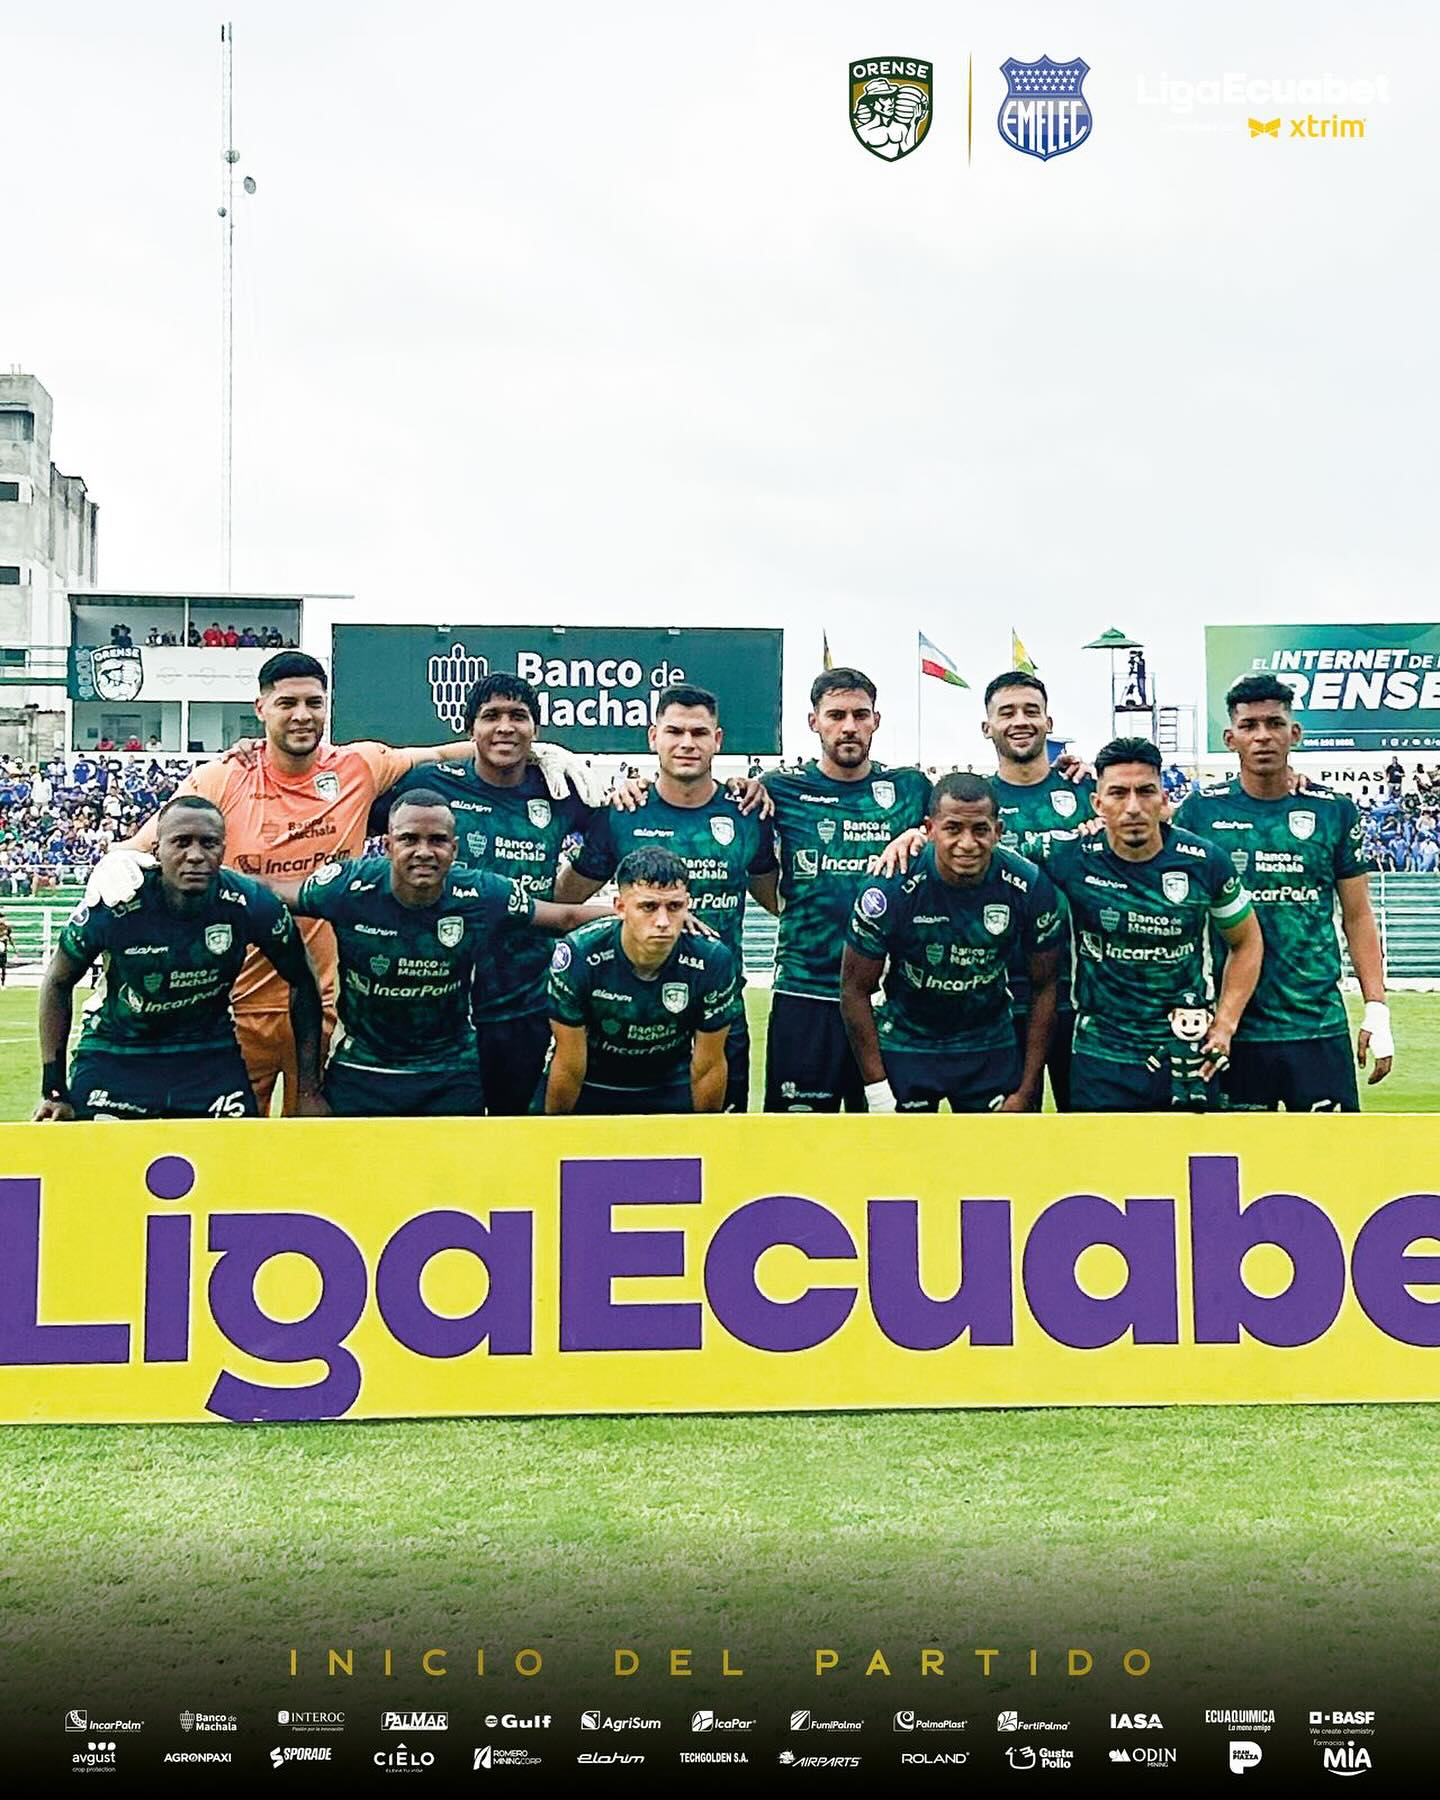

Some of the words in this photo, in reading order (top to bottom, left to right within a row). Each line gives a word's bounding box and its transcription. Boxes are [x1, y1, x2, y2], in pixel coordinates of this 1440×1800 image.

[1252, 658, 1269, 670] EL
[1270, 649, 1409, 670] INTERNET
[1408, 655, 1433, 669] DE
[518, 652, 642, 688] Banco
[650, 661, 685, 688] de
[1231, 671, 1440, 710] RENSE
[538, 690, 660, 727] achal
[843, 820, 879, 831] Banco
[495, 836, 533, 850] Banco
[843, 831, 891, 842] Machala
[495, 848, 546, 862] Machala
[1255, 851, 1291, 862] Banco
[821, 855, 881, 871] IncarP
[688, 868, 728, 880] achala
[1249, 886, 1320, 901] carPalm
[1128, 912, 1169, 925] Banco
[398, 957, 439, 968] Banco
[208, 1090, 246, 1118] 15
